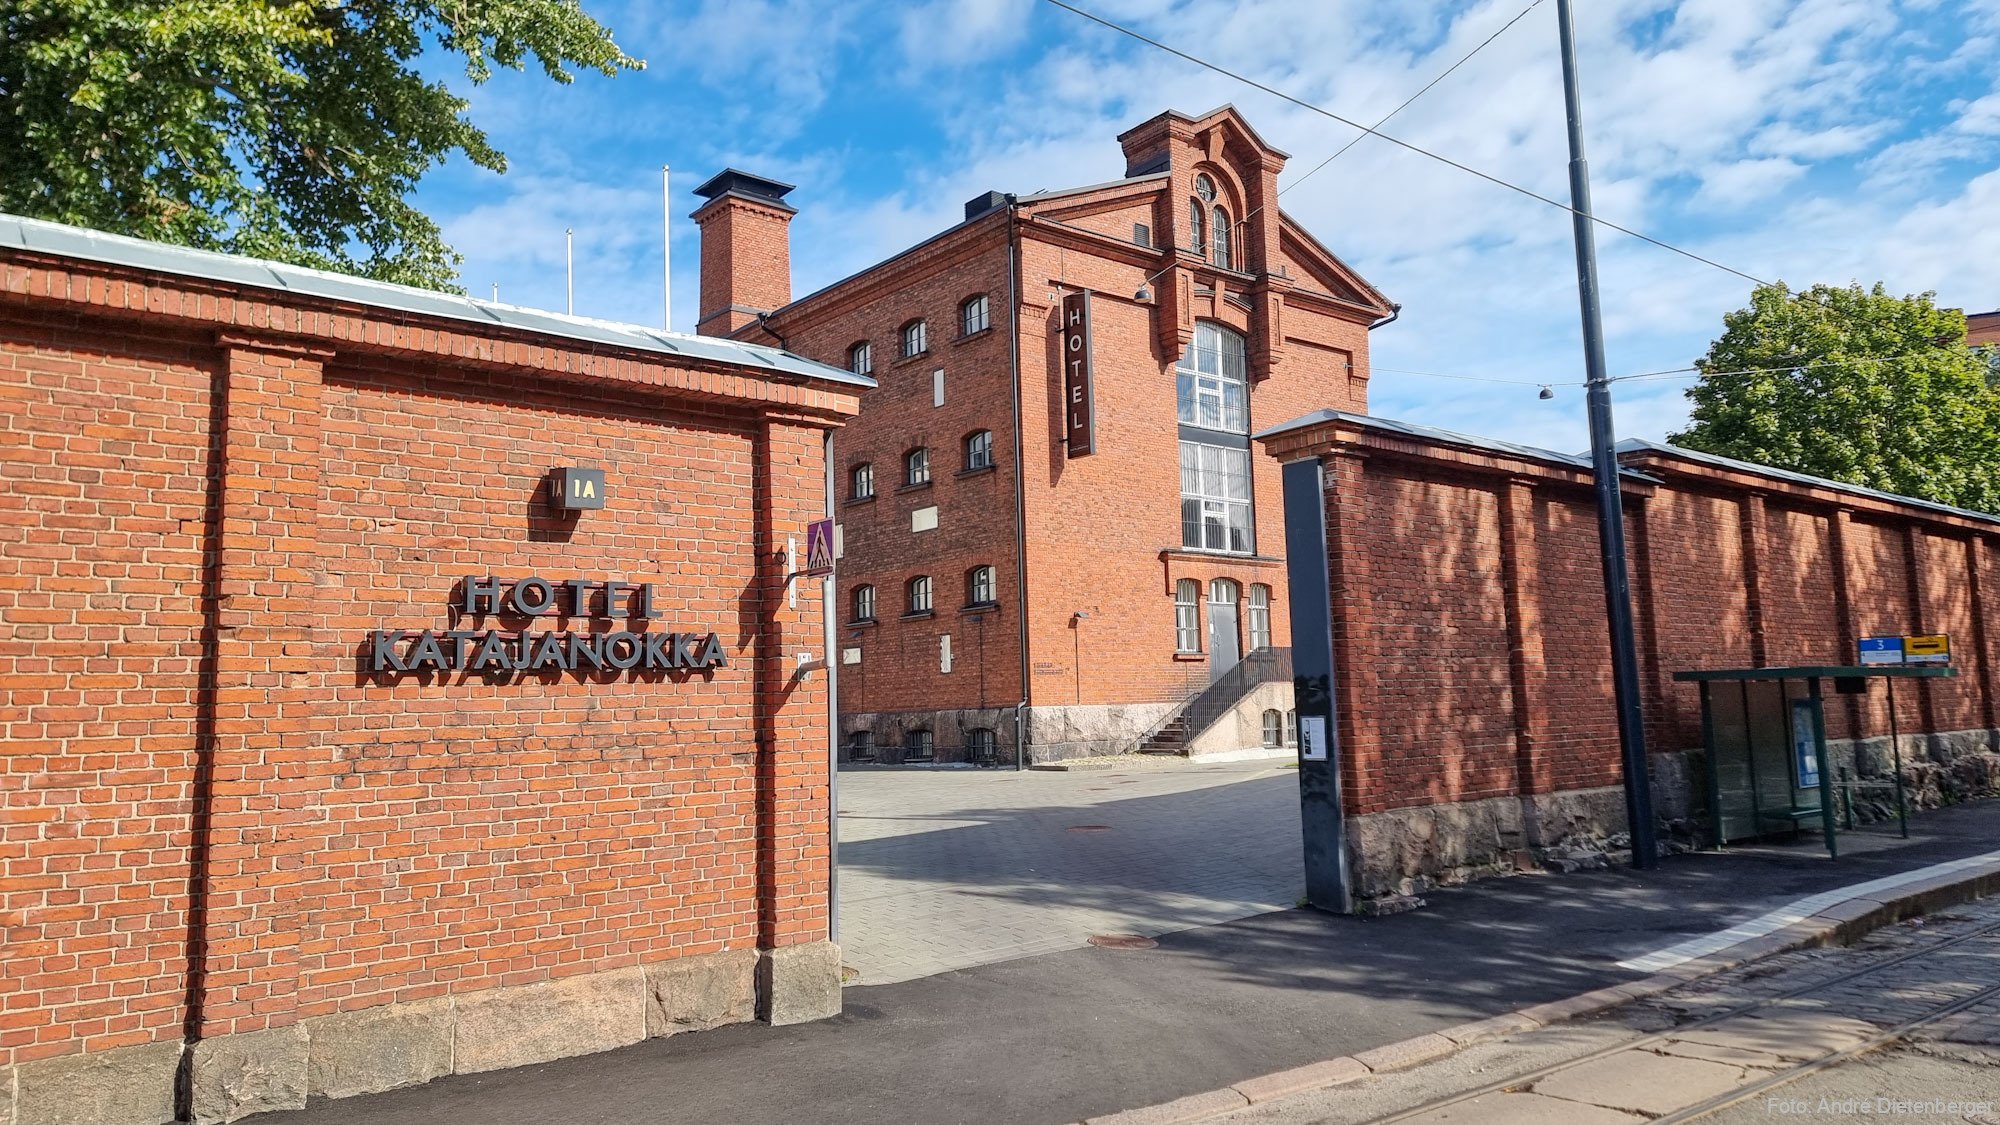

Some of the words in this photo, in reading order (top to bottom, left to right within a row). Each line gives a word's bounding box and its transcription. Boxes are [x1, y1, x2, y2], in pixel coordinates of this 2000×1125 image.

[1069, 308, 1083, 430] HOTEL
[574, 479, 595, 498] 1A
[464, 576, 663, 618] HOTEL
[373, 629, 728, 670] KATAJANOKKA
[1877, 640, 1884, 649] 3
